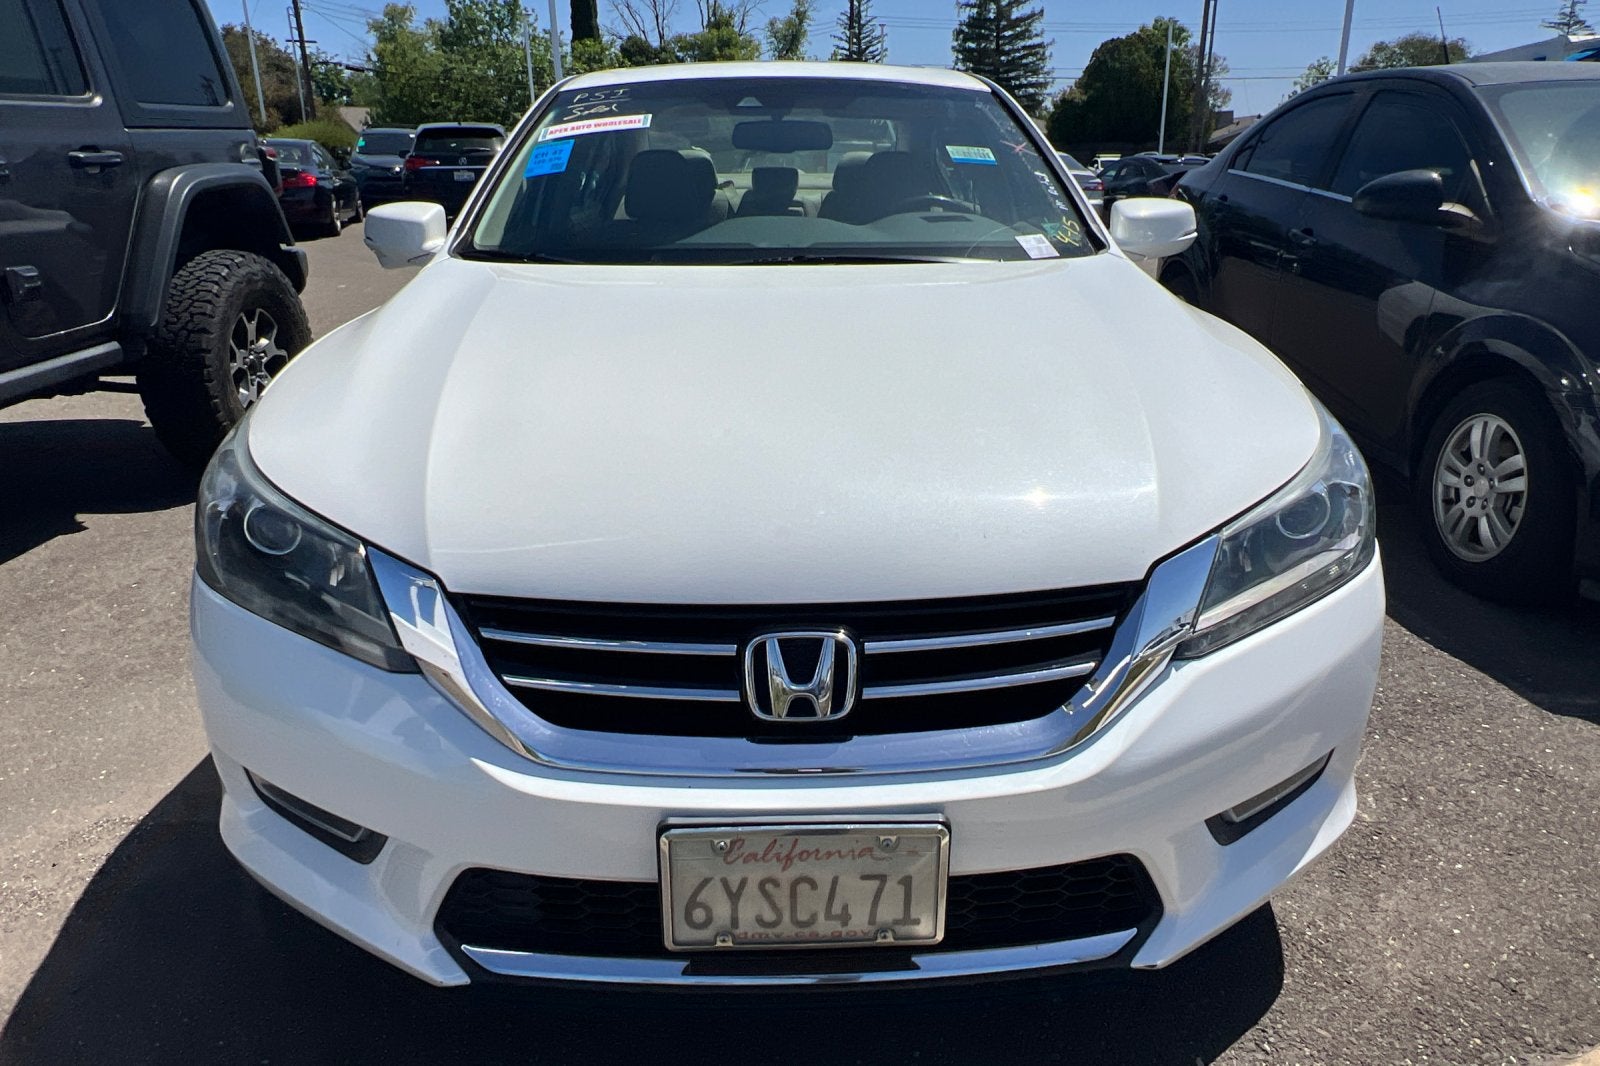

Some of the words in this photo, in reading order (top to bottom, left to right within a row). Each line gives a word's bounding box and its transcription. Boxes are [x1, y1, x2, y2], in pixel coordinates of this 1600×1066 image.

[569, 123, 593, 132] AUTO
[593, 118, 642, 129] WHOLESALE
[723, 837, 883, 872] California
[683, 873, 921, 930] 6YSC471
